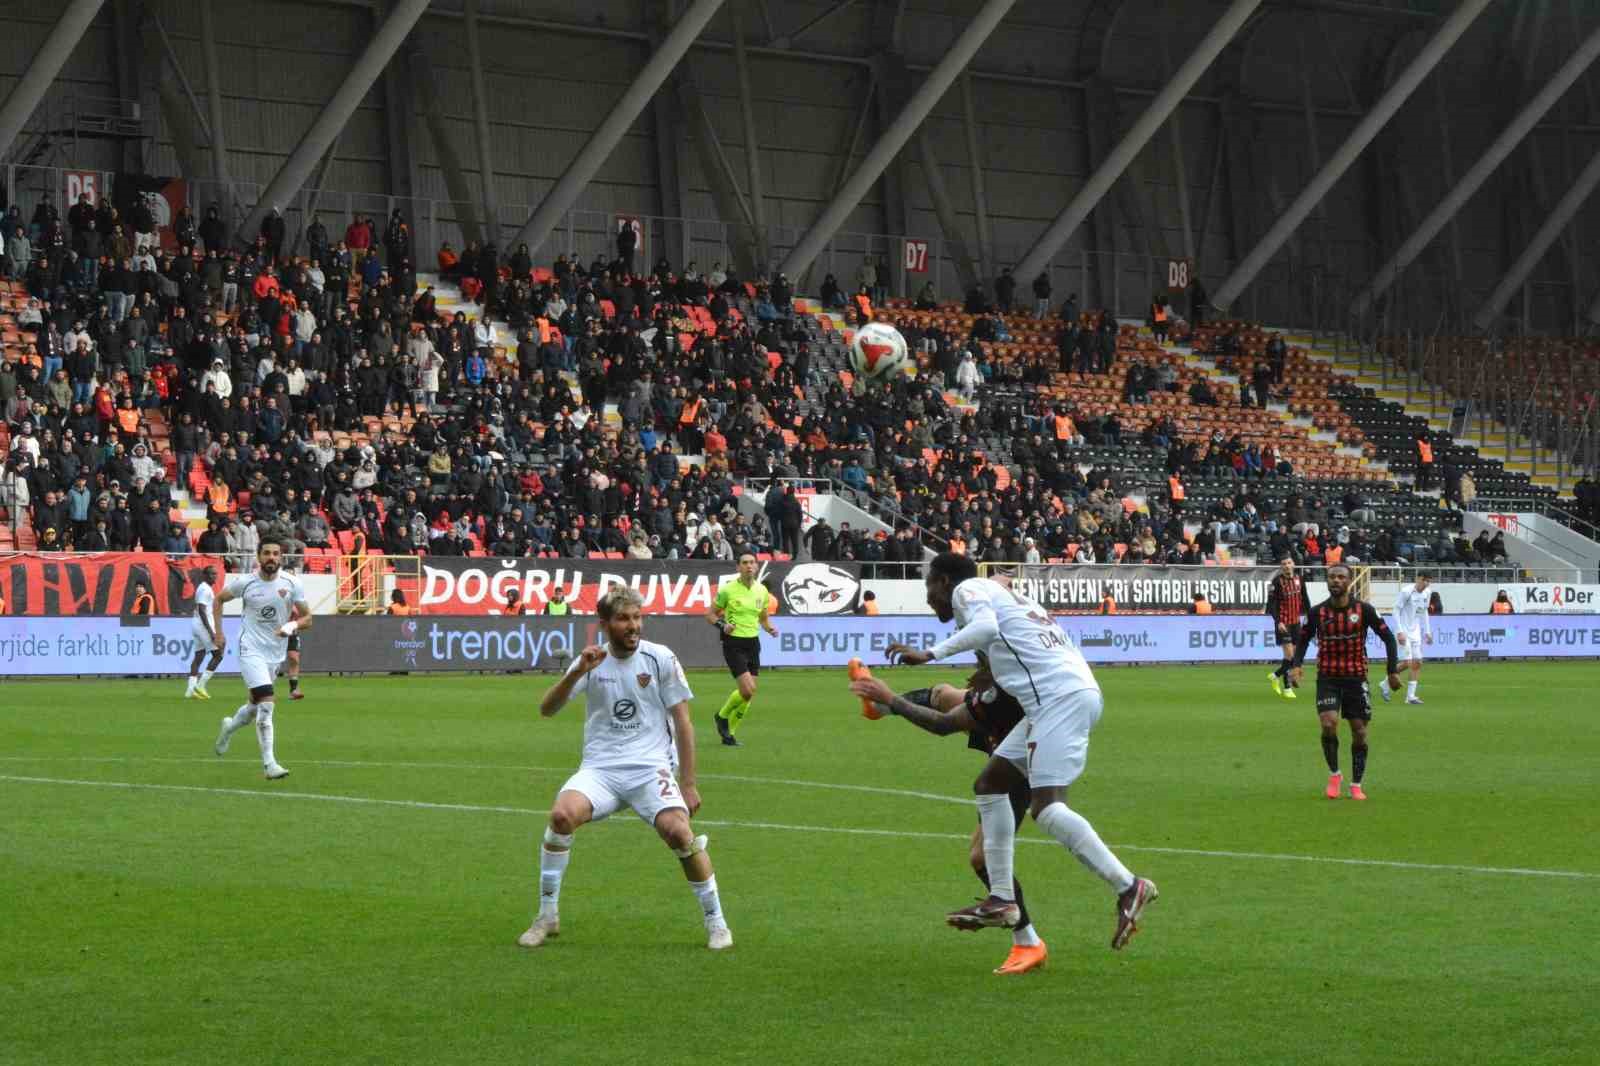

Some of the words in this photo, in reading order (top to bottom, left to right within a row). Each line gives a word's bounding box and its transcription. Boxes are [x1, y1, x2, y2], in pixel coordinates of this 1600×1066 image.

[68, 175, 95, 206] D5
[906, 243, 927, 270] D7
[1169, 261, 1187, 288] D8
[419, 559, 583, 605] DOĞRU
[1526, 586, 1548, 604] Ka
[1565, 587, 1593, 604] Der
[58, 633, 110, 657] farklı
[117, 633, 144, 657] bir
[429, 623, 574, 667] trendyol
[781, 632, 864, 652] BOYUT
[1189, 630, 1258, 649] BOYUT
[1529, 628, 1588, 645] BOYUT
